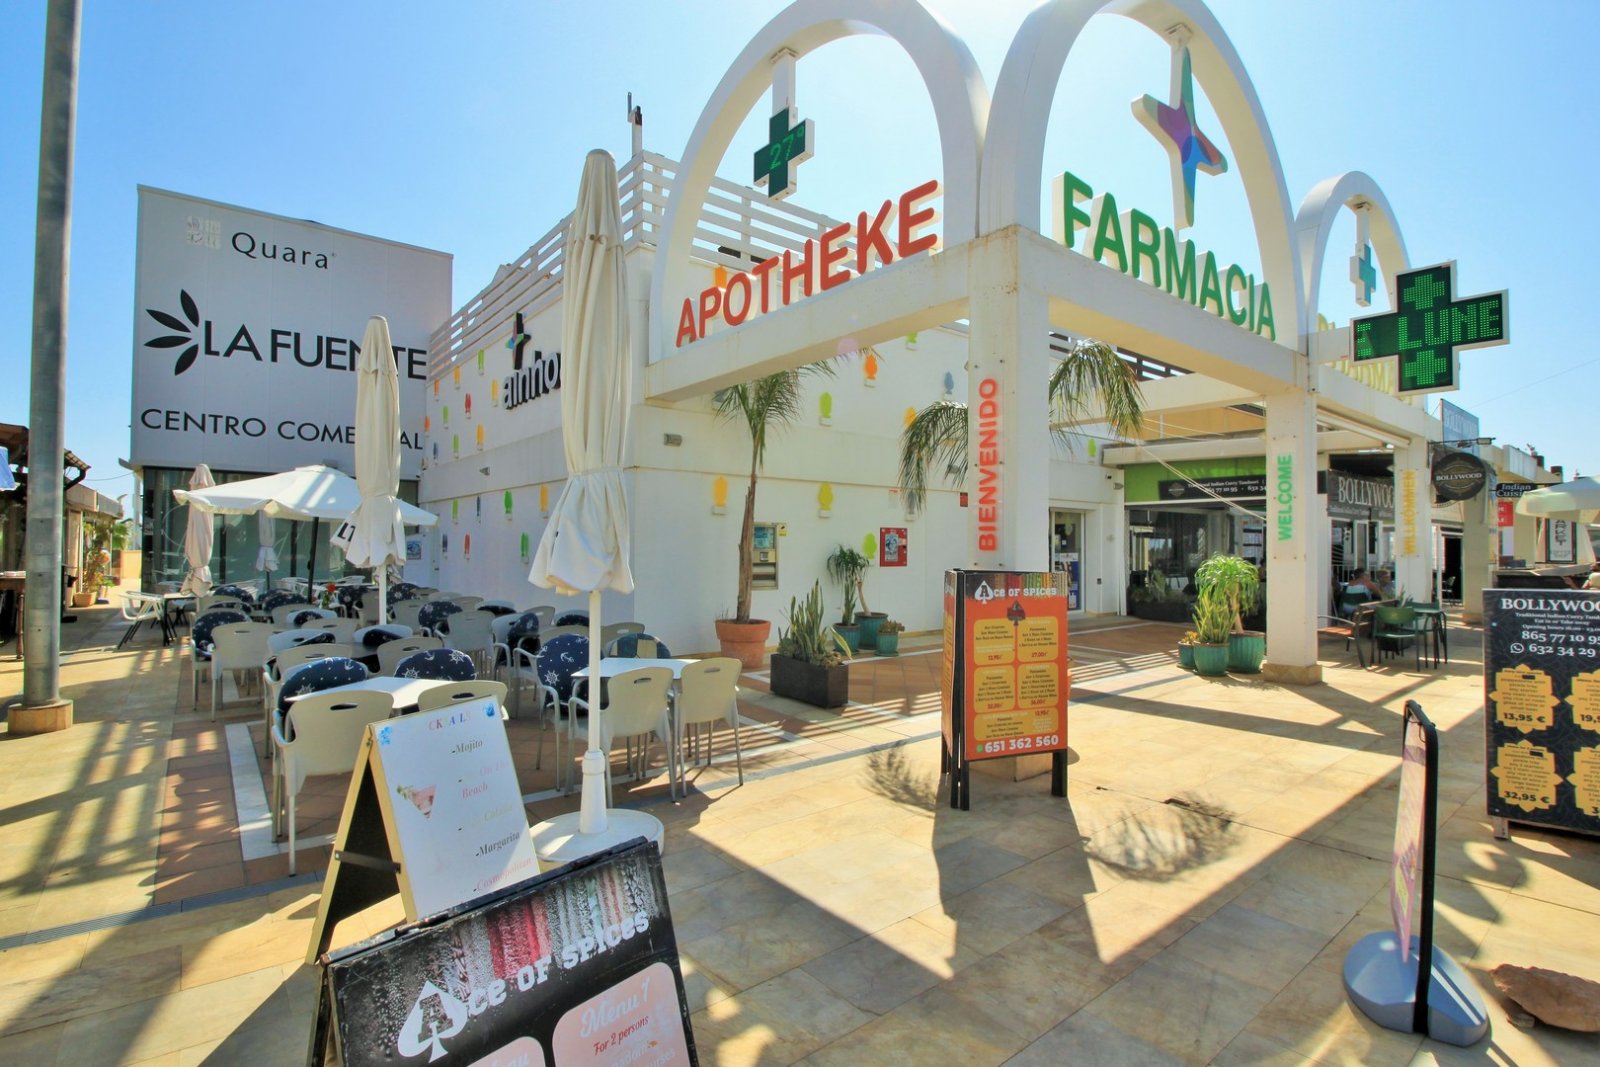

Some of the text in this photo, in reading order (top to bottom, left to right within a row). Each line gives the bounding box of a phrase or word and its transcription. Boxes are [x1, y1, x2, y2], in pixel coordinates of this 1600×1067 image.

[231, 231, 329, 270] Quara
[676, 179, 939, 348] APOTHEKE
[1062, 171, 1277, 342] FARMACIA
[204, 318, 263, 362] LA
[1397, 300, 1500, 352] LUNE
[502, 349, 561, 411] ainho
[140, 408, 424, 450] CENTRO COMEAL
[978, 378, 999, 551] BIENVENIDO
[1435, 472, 1483, 481] BOLLYWOOD
[1277, 454, 1293, 541] WELCOME
[1338, 476, 1394, 508] BOLLYWOO
[1496, 489, 1522, 498] Cuisi
[1521, 630, 1547, 642] 865
[1549, 633, 1566, 643] 77
[1569, 634, 1585, 642] 10
[1528, 643, 1596, 658] 632 34 29
[1503, 712, 1533, 722] 13,95
[985, 734, 1059, 753] 651 362 560
[462, 781, 488, 799] Beach
[1503, 790, 1537, 802] 32,95
[580, 993, 640, 1038] Menu
[593, 1039, 610, 1056] For
[610, 1032, 618, 1046] 2
[618, 1016, 649, 1045] persons
